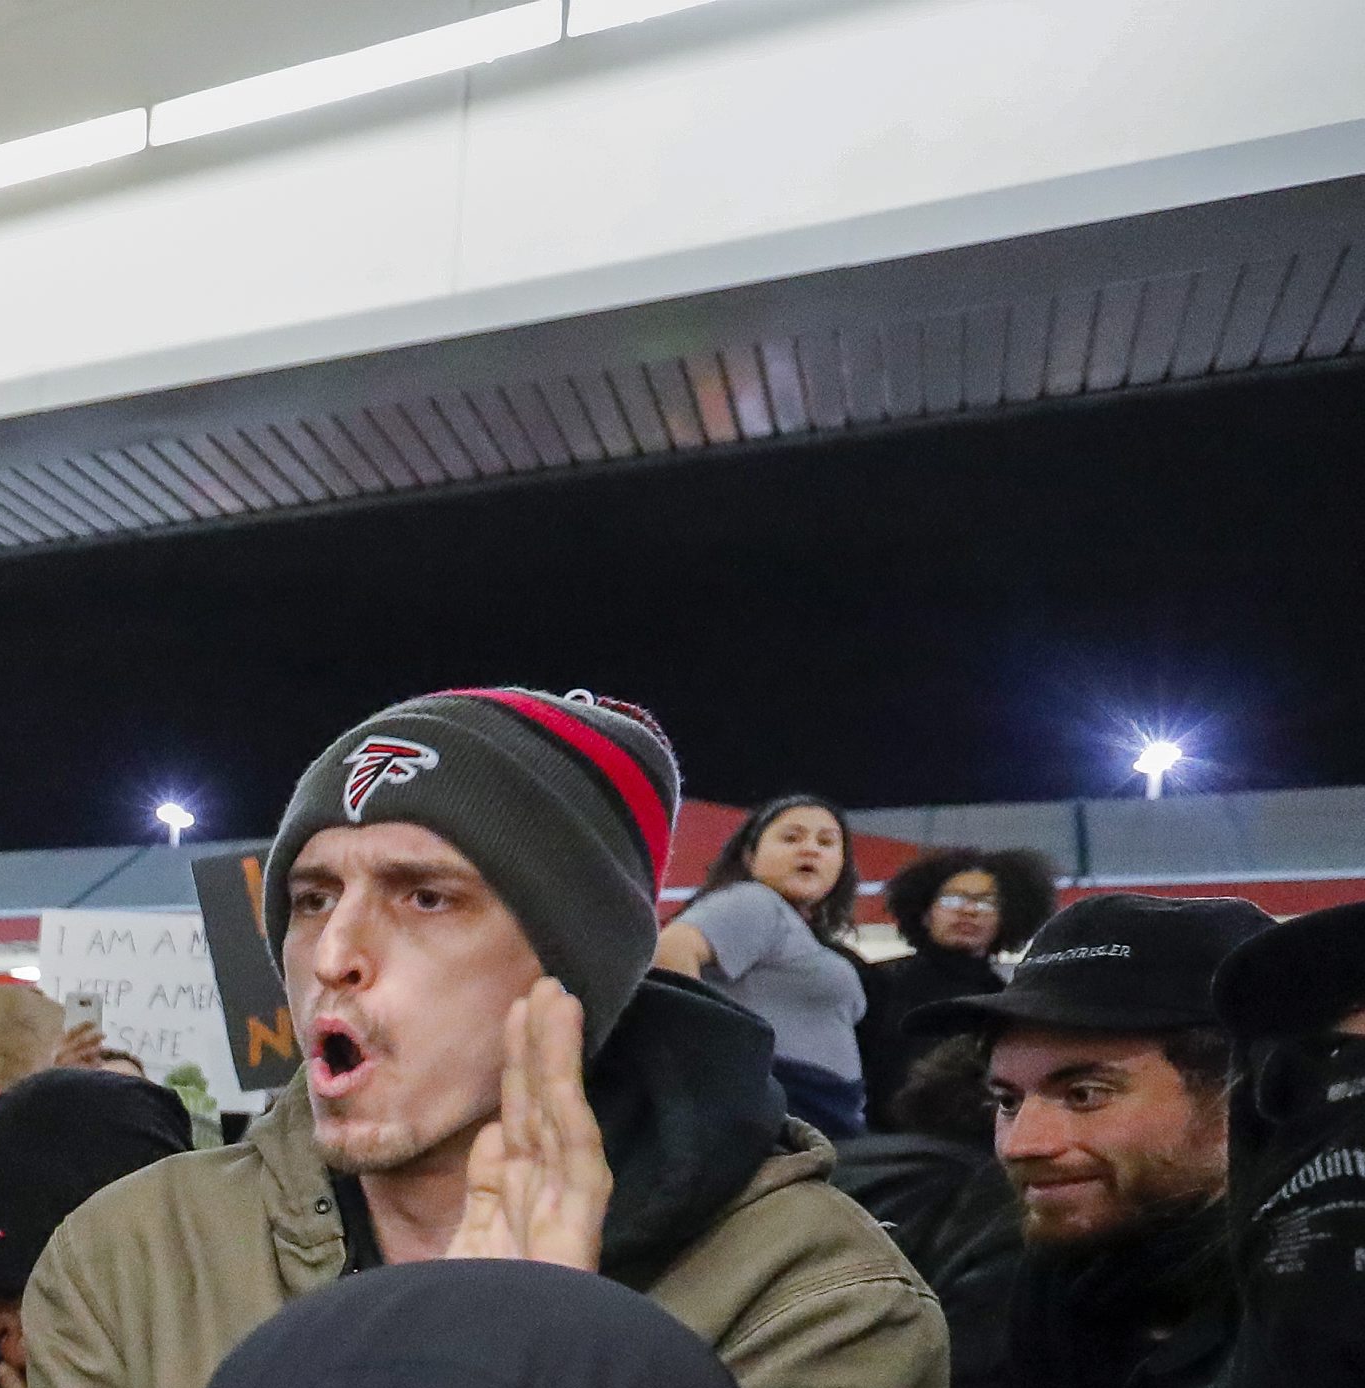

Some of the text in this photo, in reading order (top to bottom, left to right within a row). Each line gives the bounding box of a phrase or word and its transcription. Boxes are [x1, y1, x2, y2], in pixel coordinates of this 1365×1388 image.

[58, 926, 66, 954] I
[87, 929, 137, 955] AM
[152, 929, 177, 954] A
